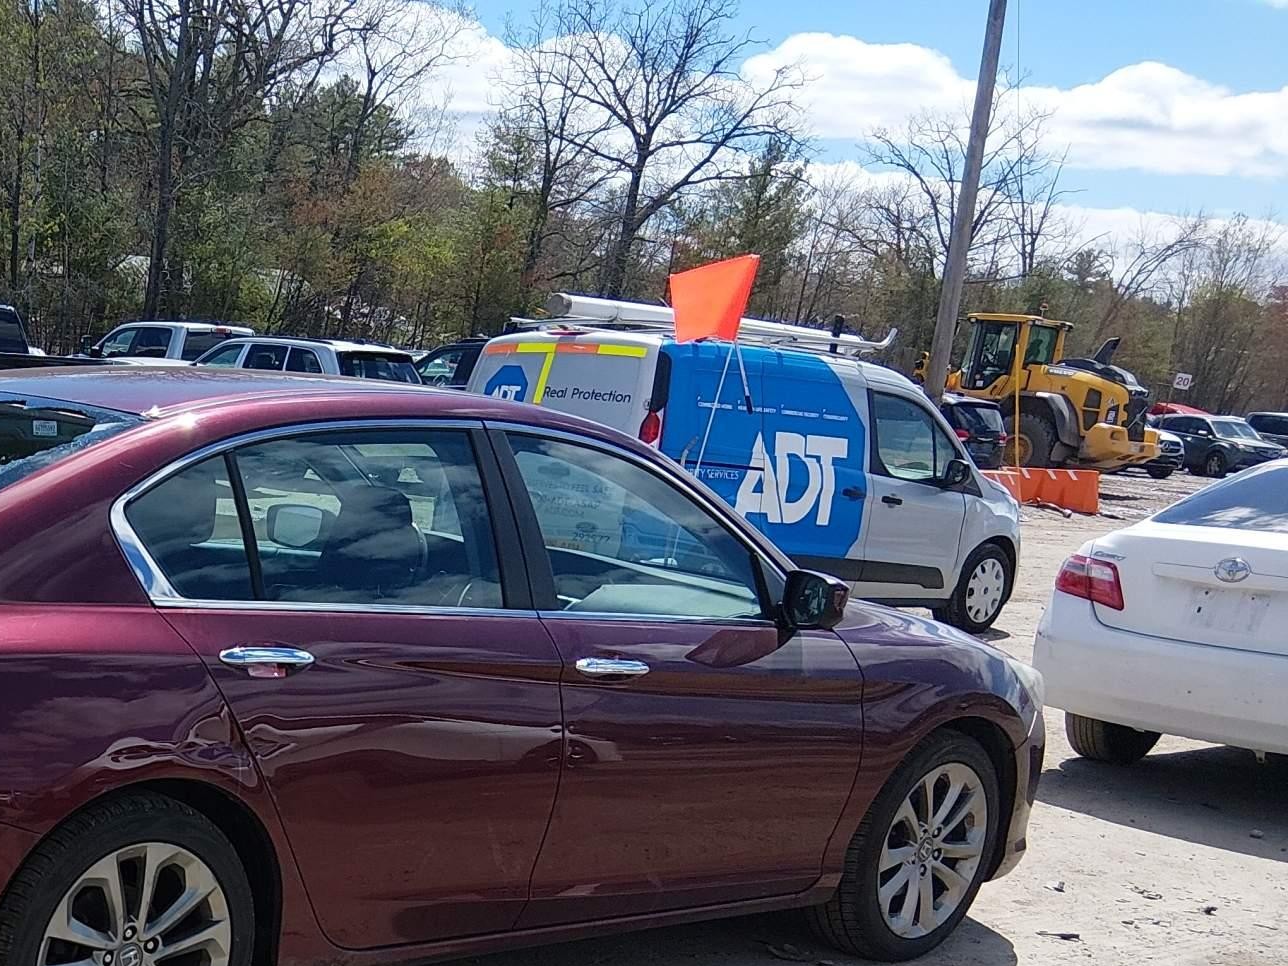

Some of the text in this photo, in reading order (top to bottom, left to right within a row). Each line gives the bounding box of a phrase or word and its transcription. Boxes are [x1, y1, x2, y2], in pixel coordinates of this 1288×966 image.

[1175, 376, 1190, 387] 20
[492, 385, 522, 400] ADT
[543, 386, 632, 403] Real Protection
[706, 469, 740, 481] SERVICES
[735, 431, 849, 526] ADT
